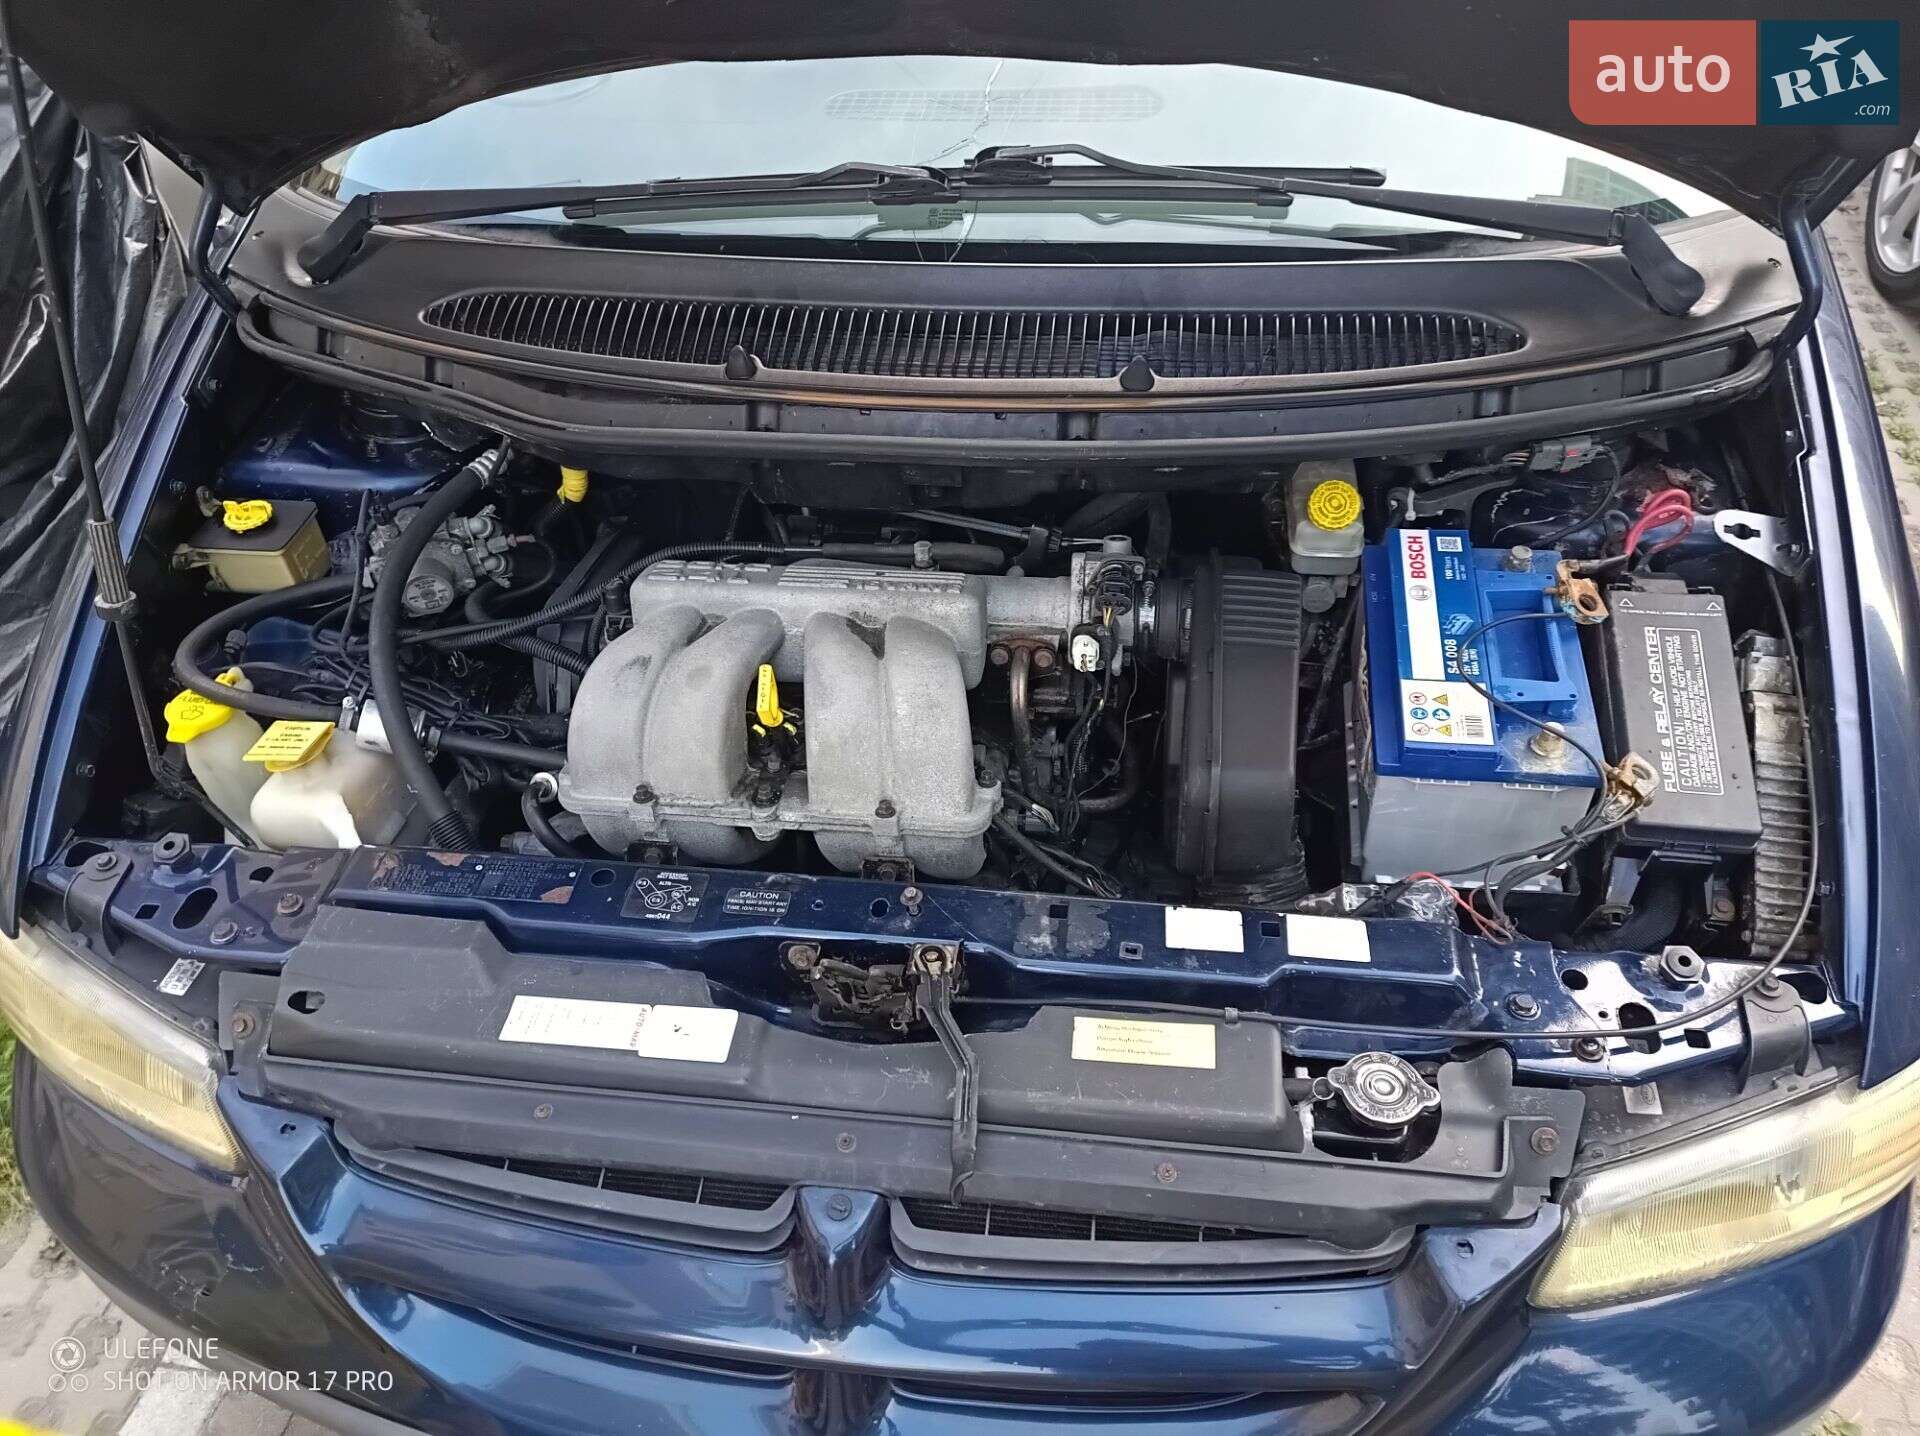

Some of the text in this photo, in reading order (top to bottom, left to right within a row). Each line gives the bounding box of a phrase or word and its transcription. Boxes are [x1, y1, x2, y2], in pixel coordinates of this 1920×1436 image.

[1407, 535, 1427, 580] BOSCH
[1444, 638, 1458, 659] 008
[1669, 665, 1678, 685] AVOID
[1678, 672, 1686, 687] NOT
[1644, 626, 1677, 792] FUSE & RELAY CENTER
[1673, 721, 1692, 786] CAUTION!
[739, 891, 779, 900] CAUTION
